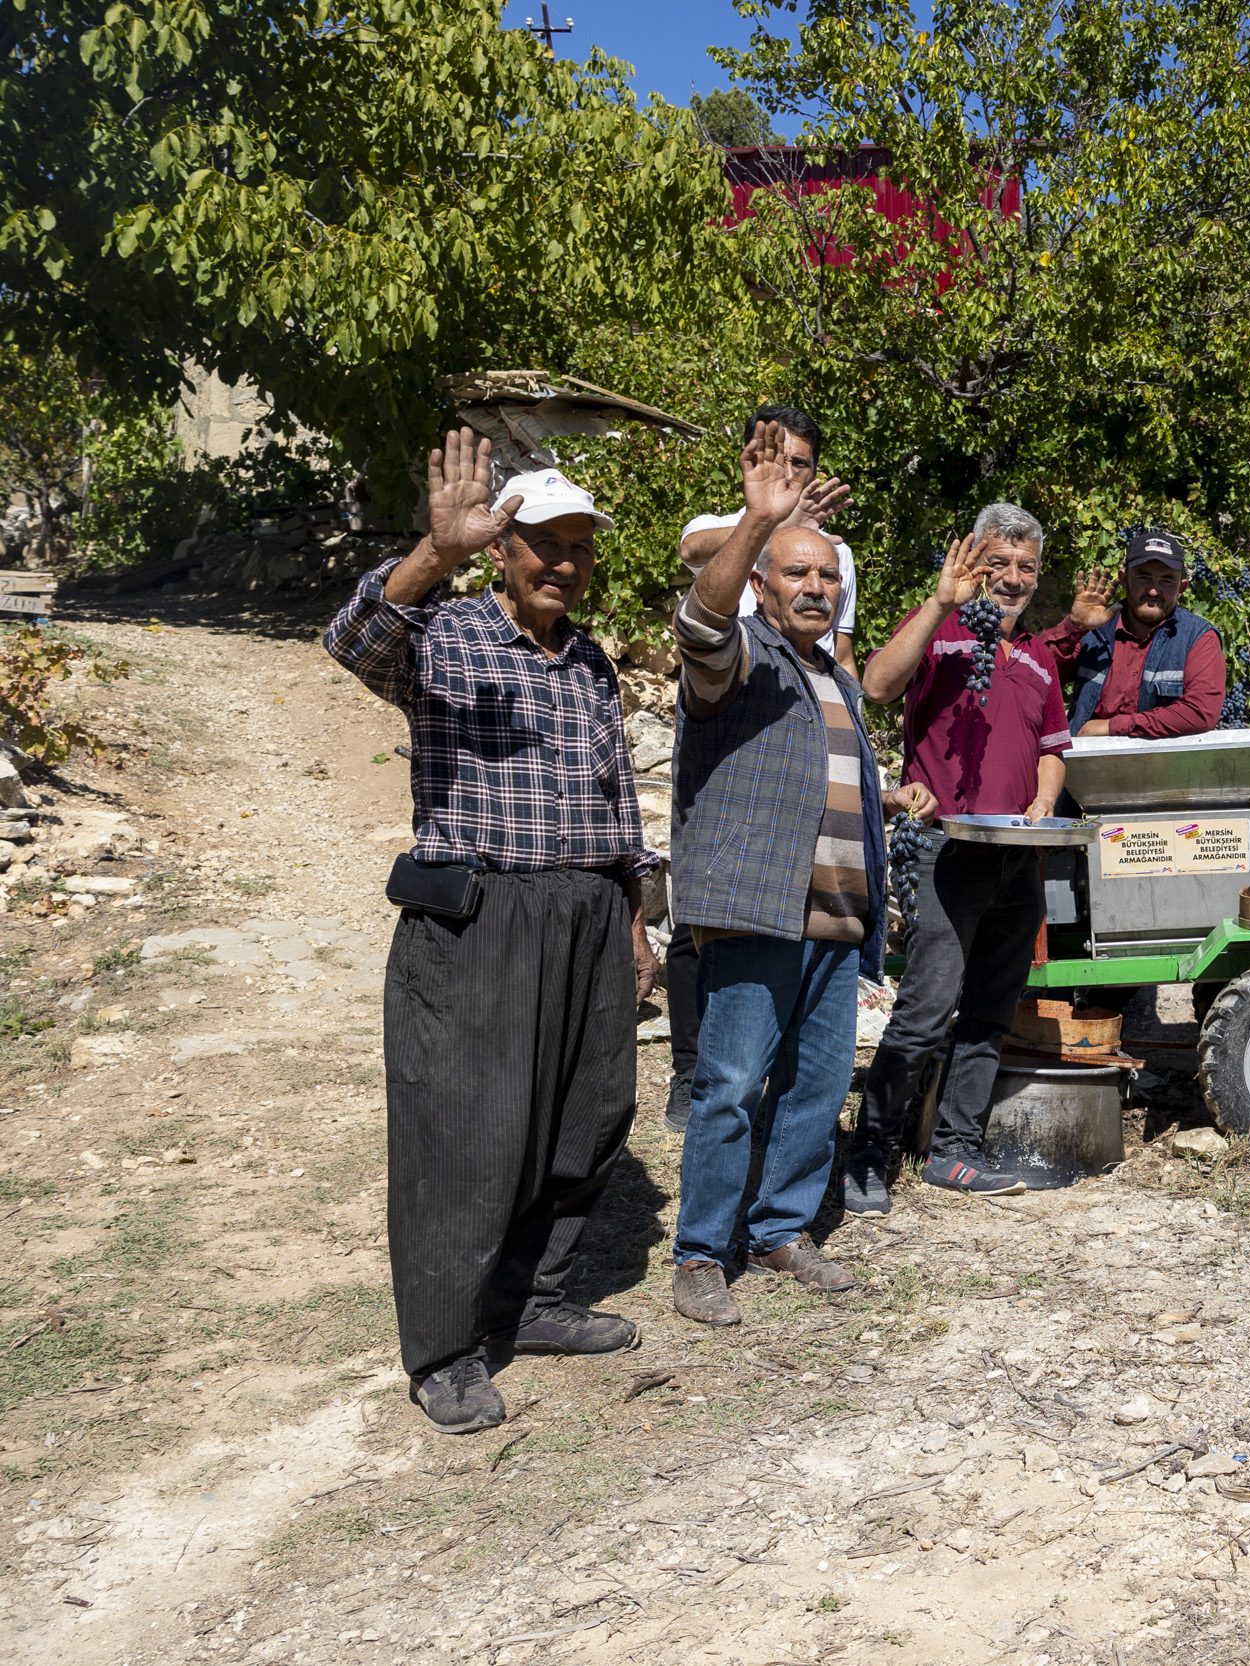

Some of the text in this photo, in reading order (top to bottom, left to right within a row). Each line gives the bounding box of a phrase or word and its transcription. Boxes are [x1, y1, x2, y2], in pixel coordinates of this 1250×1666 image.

[1130, 830, 1159, 840] MERSİN
[1205, 828, 1233, 836] MERSİN
[1121, 839, 1168, 848] BÜYÜKŞEHİR
[1195, 836, 1242, 845] BÜYÜKŞEHİR
[1126, 847, 1165, 856] BELEDİYESİ
[1200, 844, 1239, 853] BELEDİYESİ
[1118, 855, 1173, 864] ARMAĞANIDIR
[1192, 852, 1246, 861] ARMAĞANIDIR
